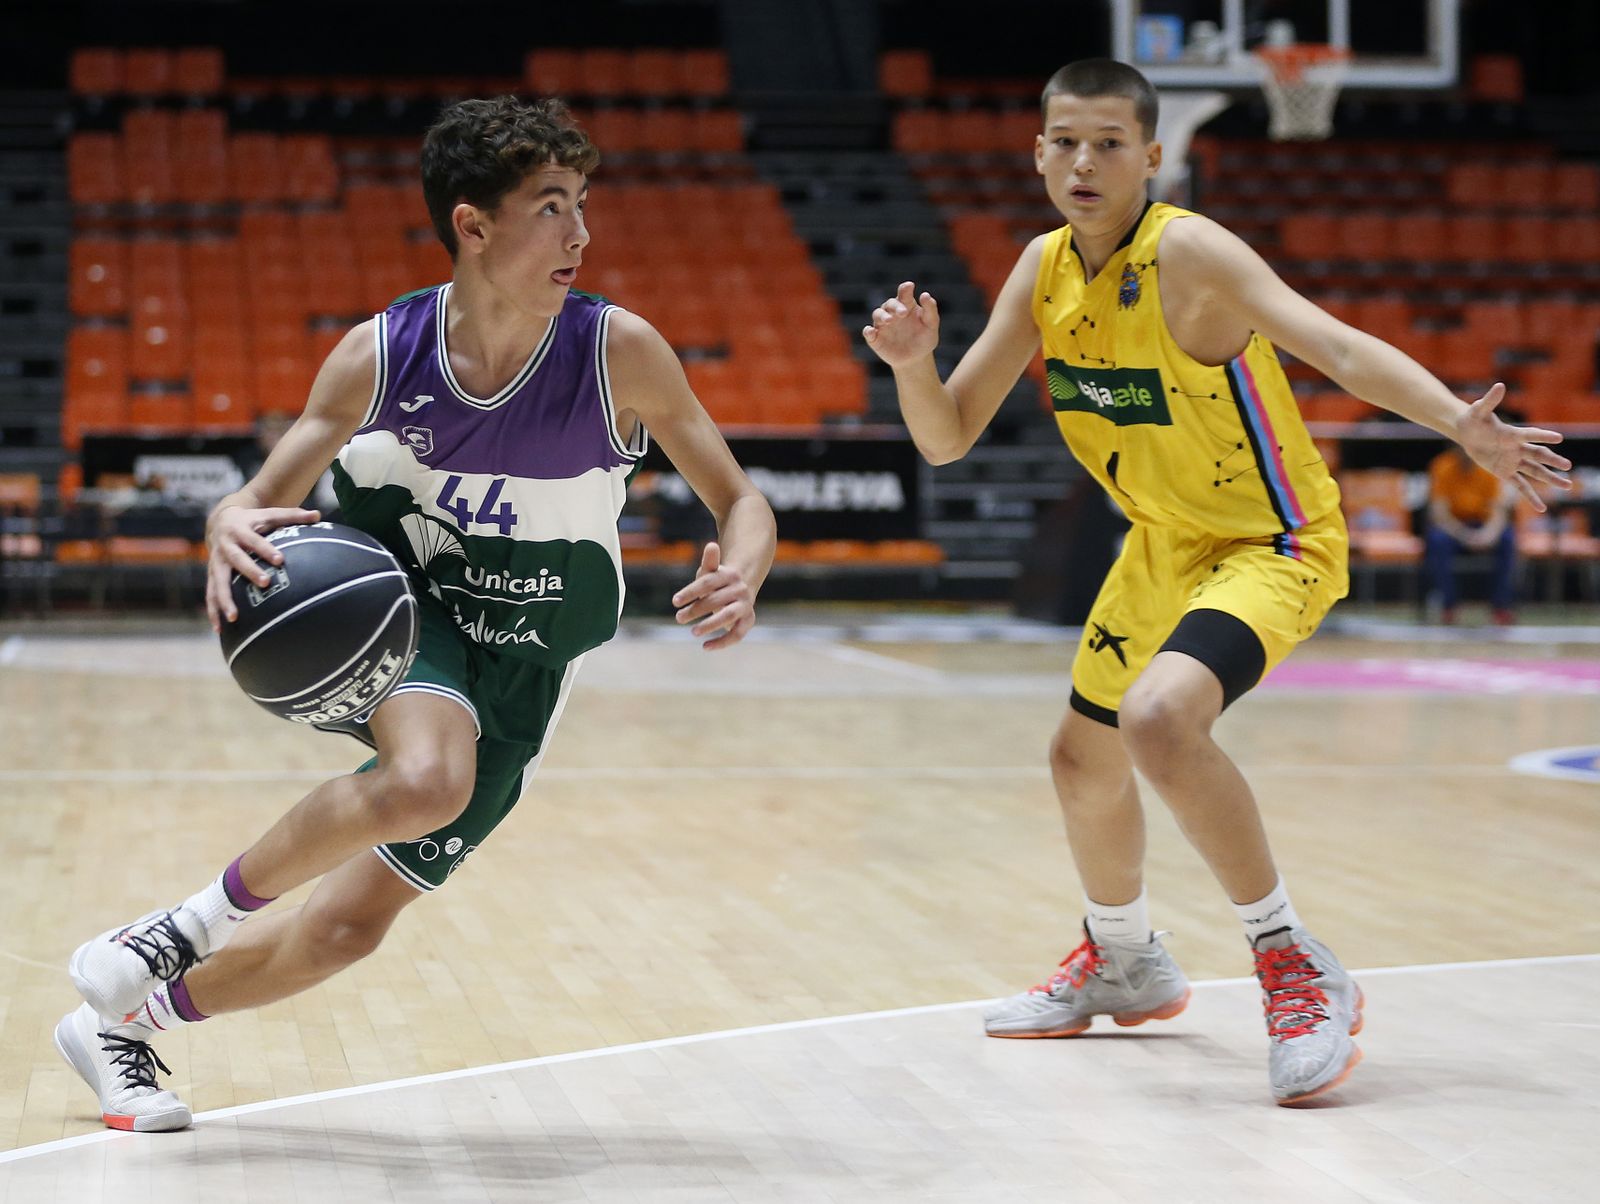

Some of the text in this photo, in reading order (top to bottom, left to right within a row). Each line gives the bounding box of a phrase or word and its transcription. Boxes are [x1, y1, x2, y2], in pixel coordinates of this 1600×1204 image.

[436, 475, 517, 536] 44
[465, 566, 564, 597] Unicaja
[290, 654, 403, 724] TF-1000
